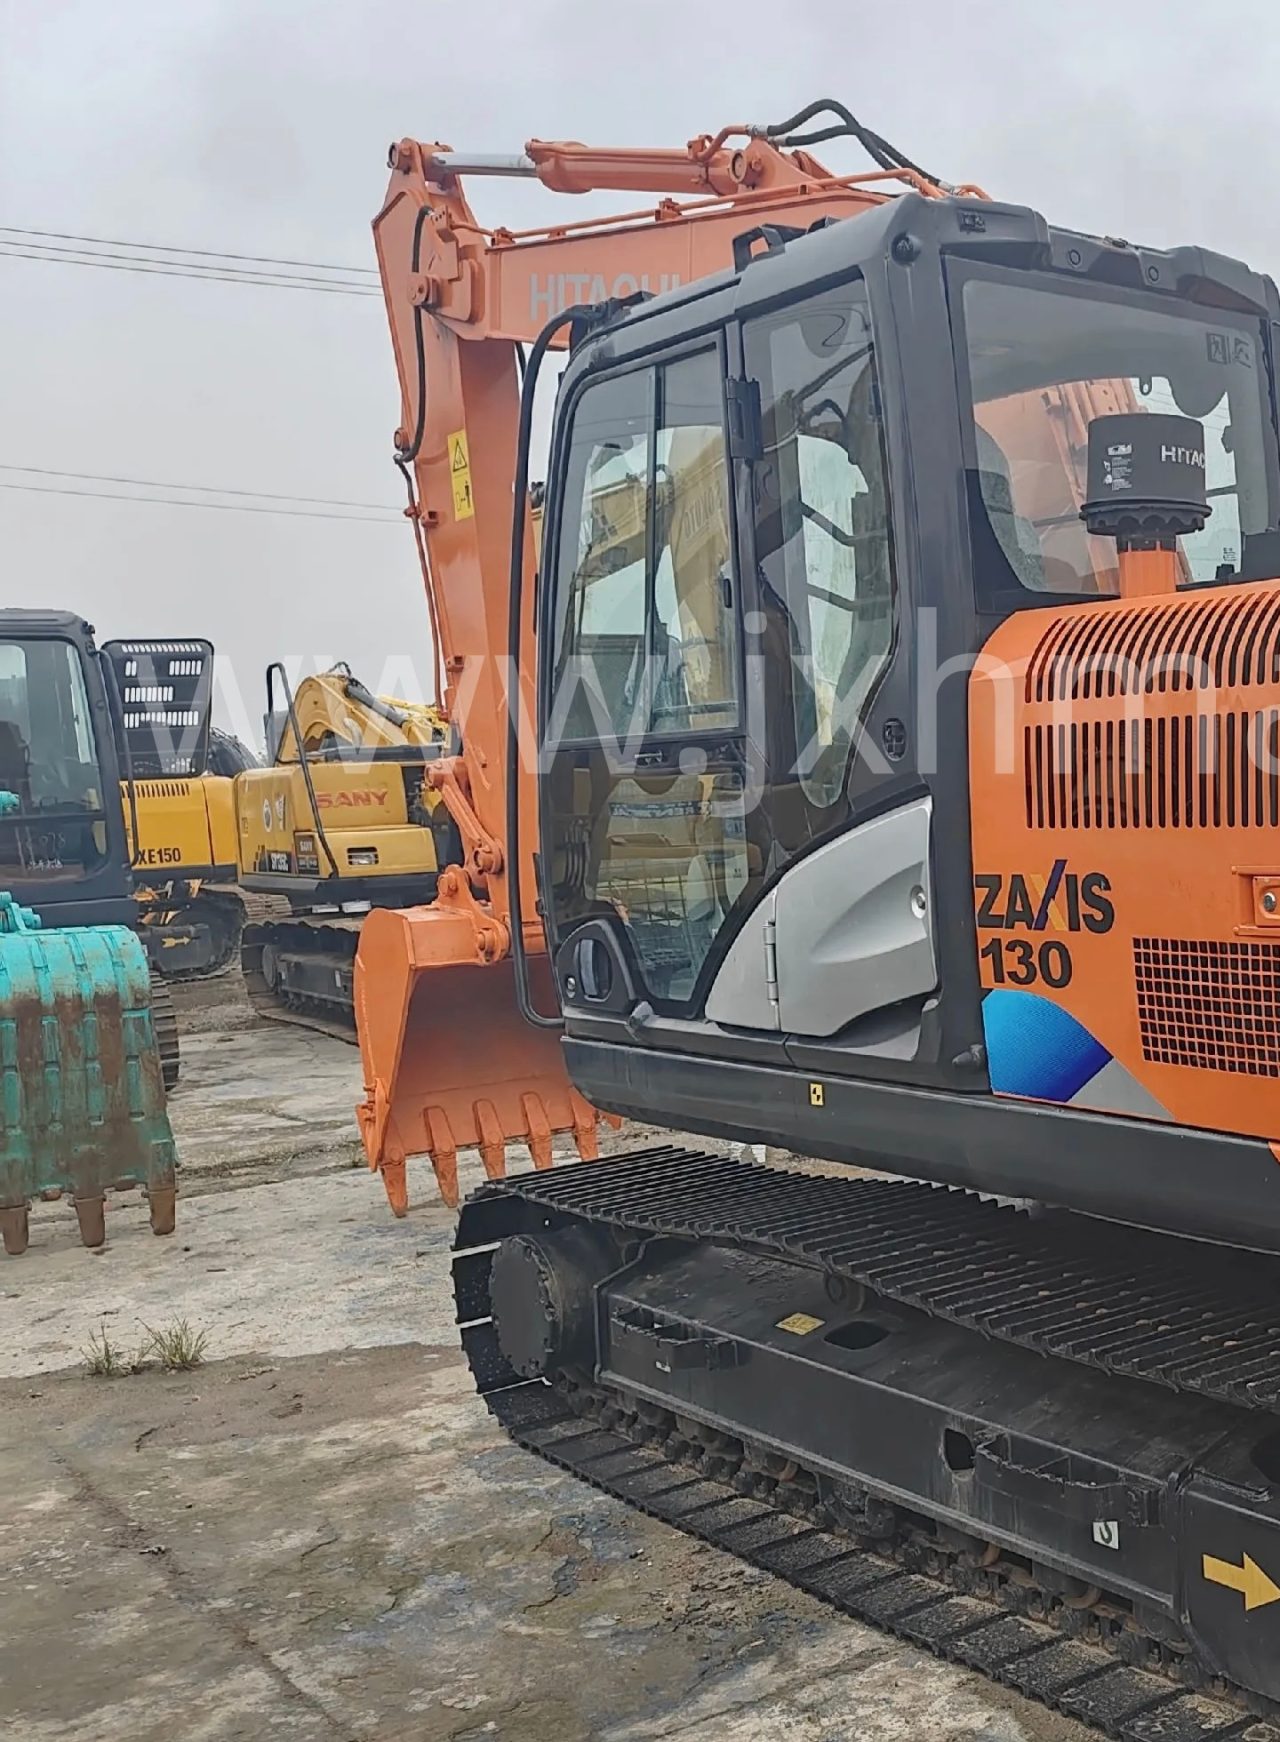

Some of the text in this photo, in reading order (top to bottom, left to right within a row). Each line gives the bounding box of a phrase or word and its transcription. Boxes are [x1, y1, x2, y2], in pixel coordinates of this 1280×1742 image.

[316, 789, 388, 809] SANY
[139, 847, 181, 865] XE150
[975, 859, 1115, 934] ZAXIS
[981, 938, 1073, 989] 130
